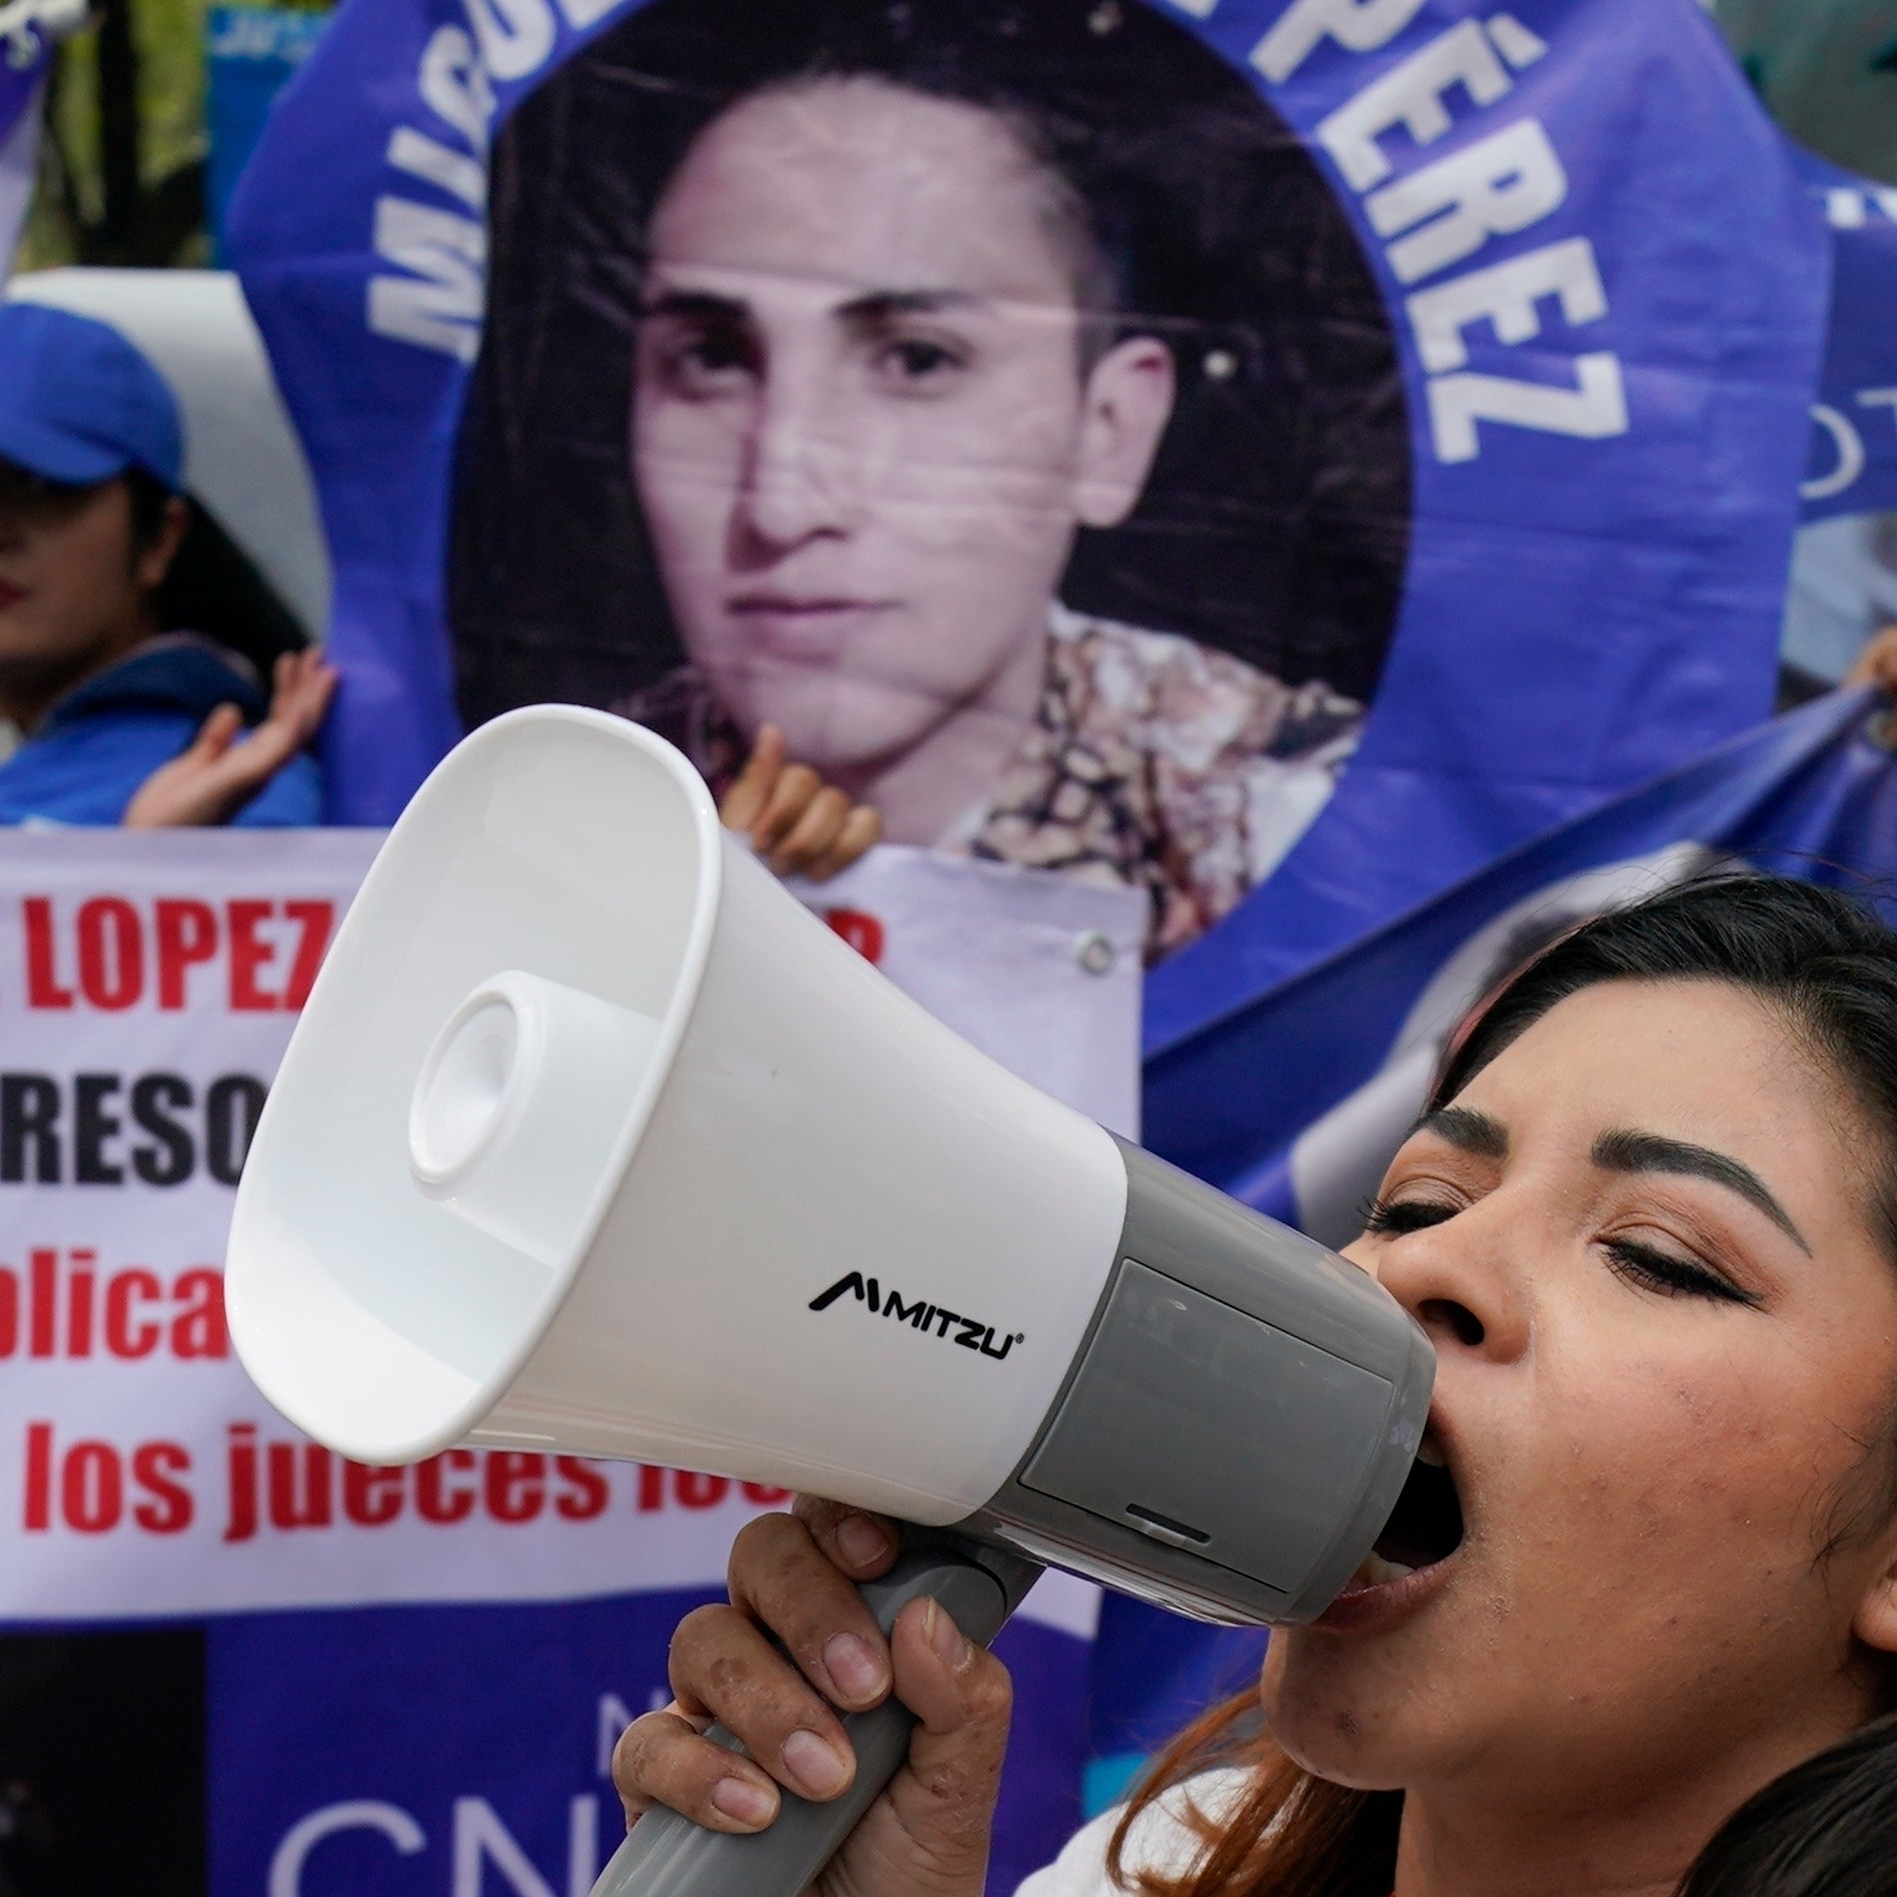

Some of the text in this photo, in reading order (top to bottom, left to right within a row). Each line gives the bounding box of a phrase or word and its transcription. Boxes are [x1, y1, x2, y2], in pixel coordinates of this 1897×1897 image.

[365, 0, 625, 366] MIGU
[1247, 0, 1631, 466] PÉREZ
[21, 894, 335, 1014] LOPEZ
[22, 1420, 196, 1538] los
[221, 1423, 610, 1548] jueces
